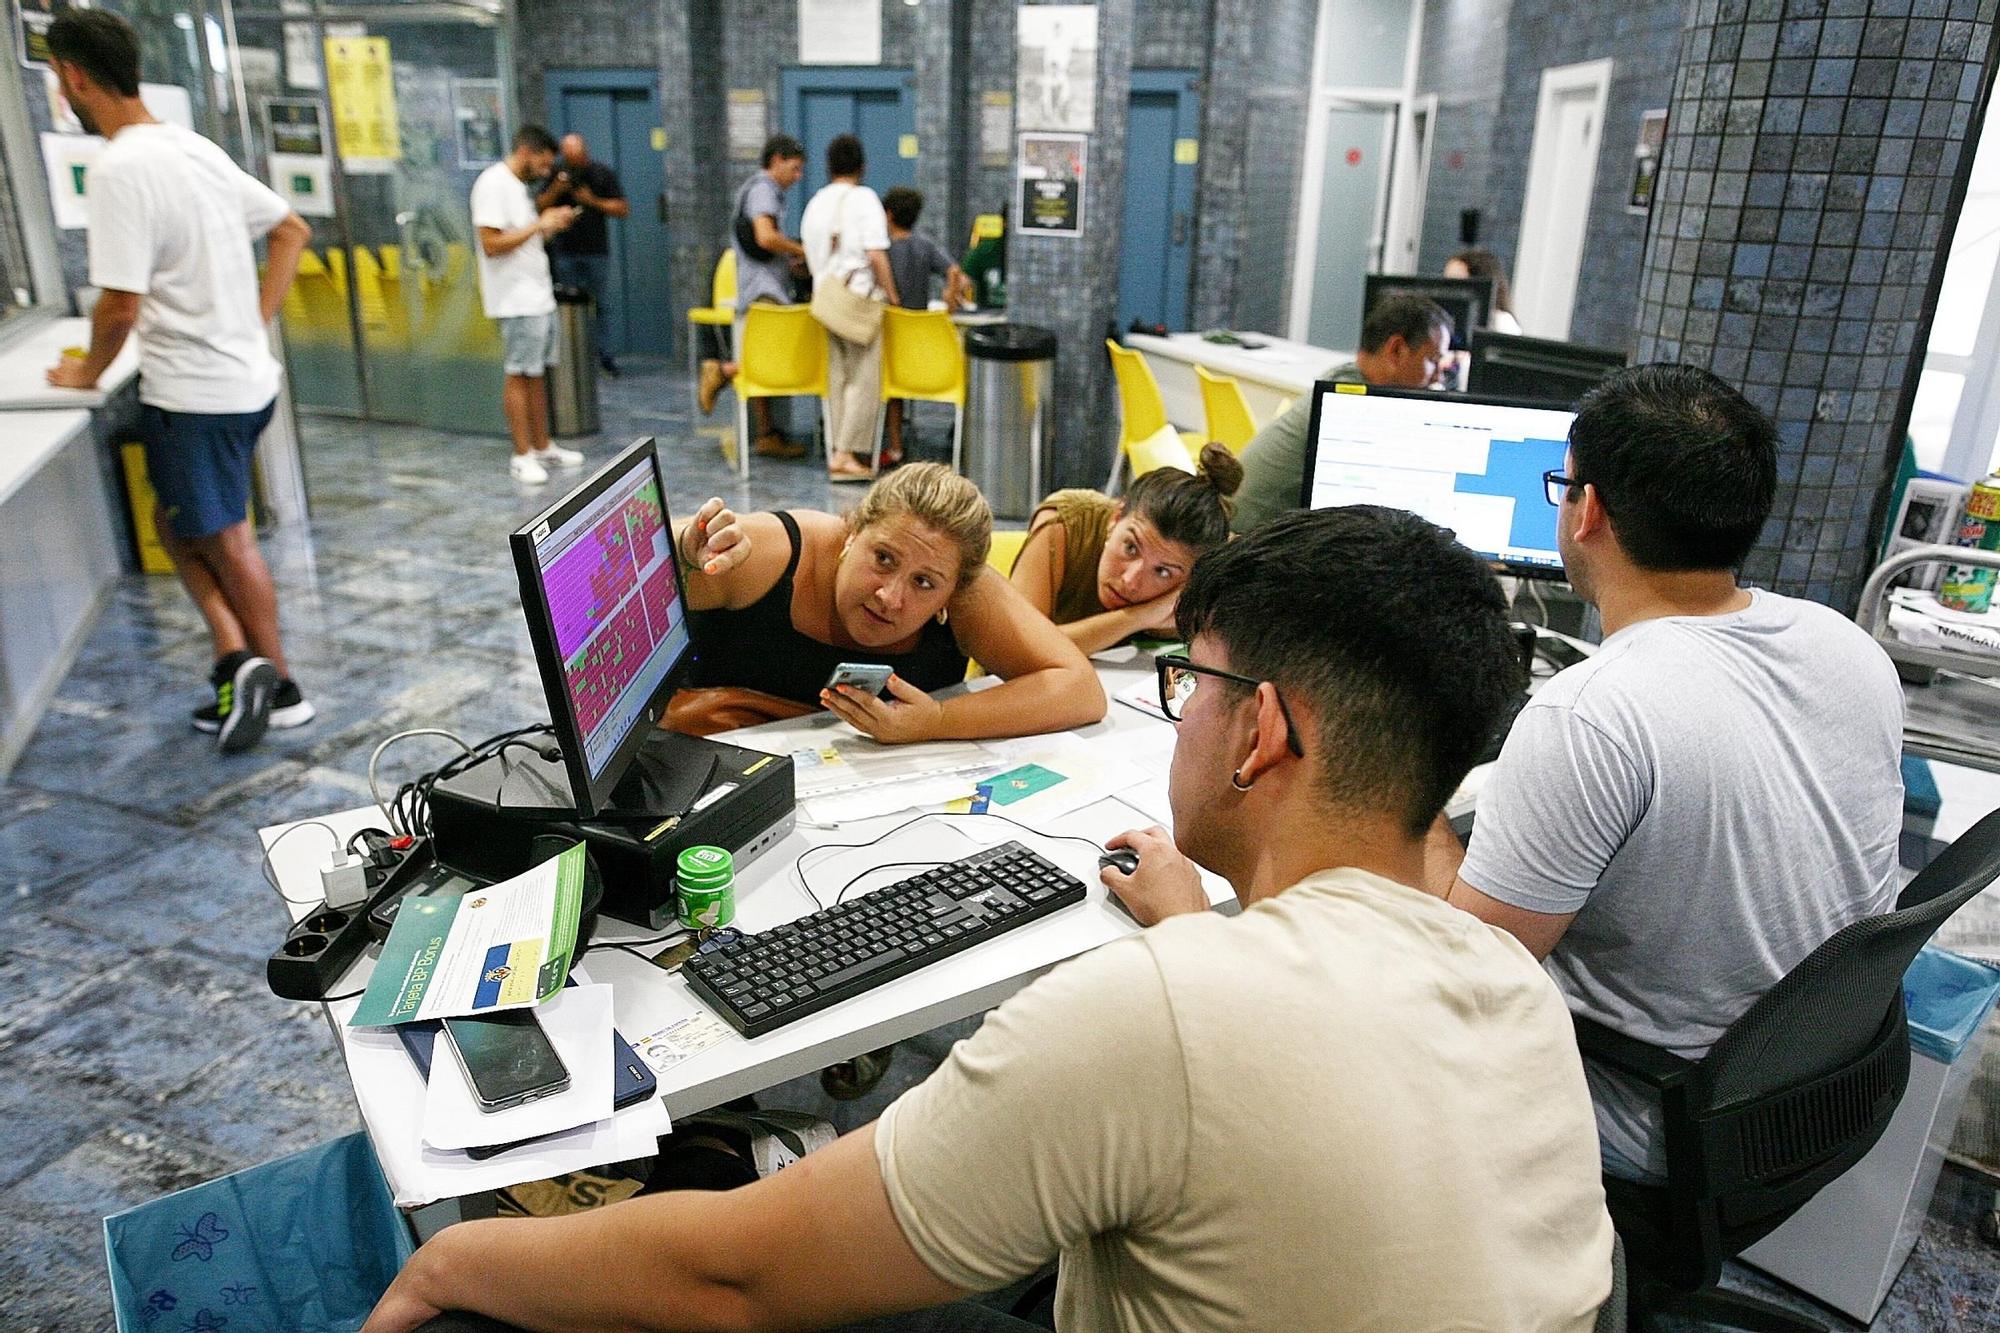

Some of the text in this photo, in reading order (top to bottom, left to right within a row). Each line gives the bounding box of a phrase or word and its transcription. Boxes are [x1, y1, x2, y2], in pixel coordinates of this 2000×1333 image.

[418, 937, 442, 966] Bonus
[411, 966, 428, 982] BP
[396, 983, 422, 1016] Tarjeta
